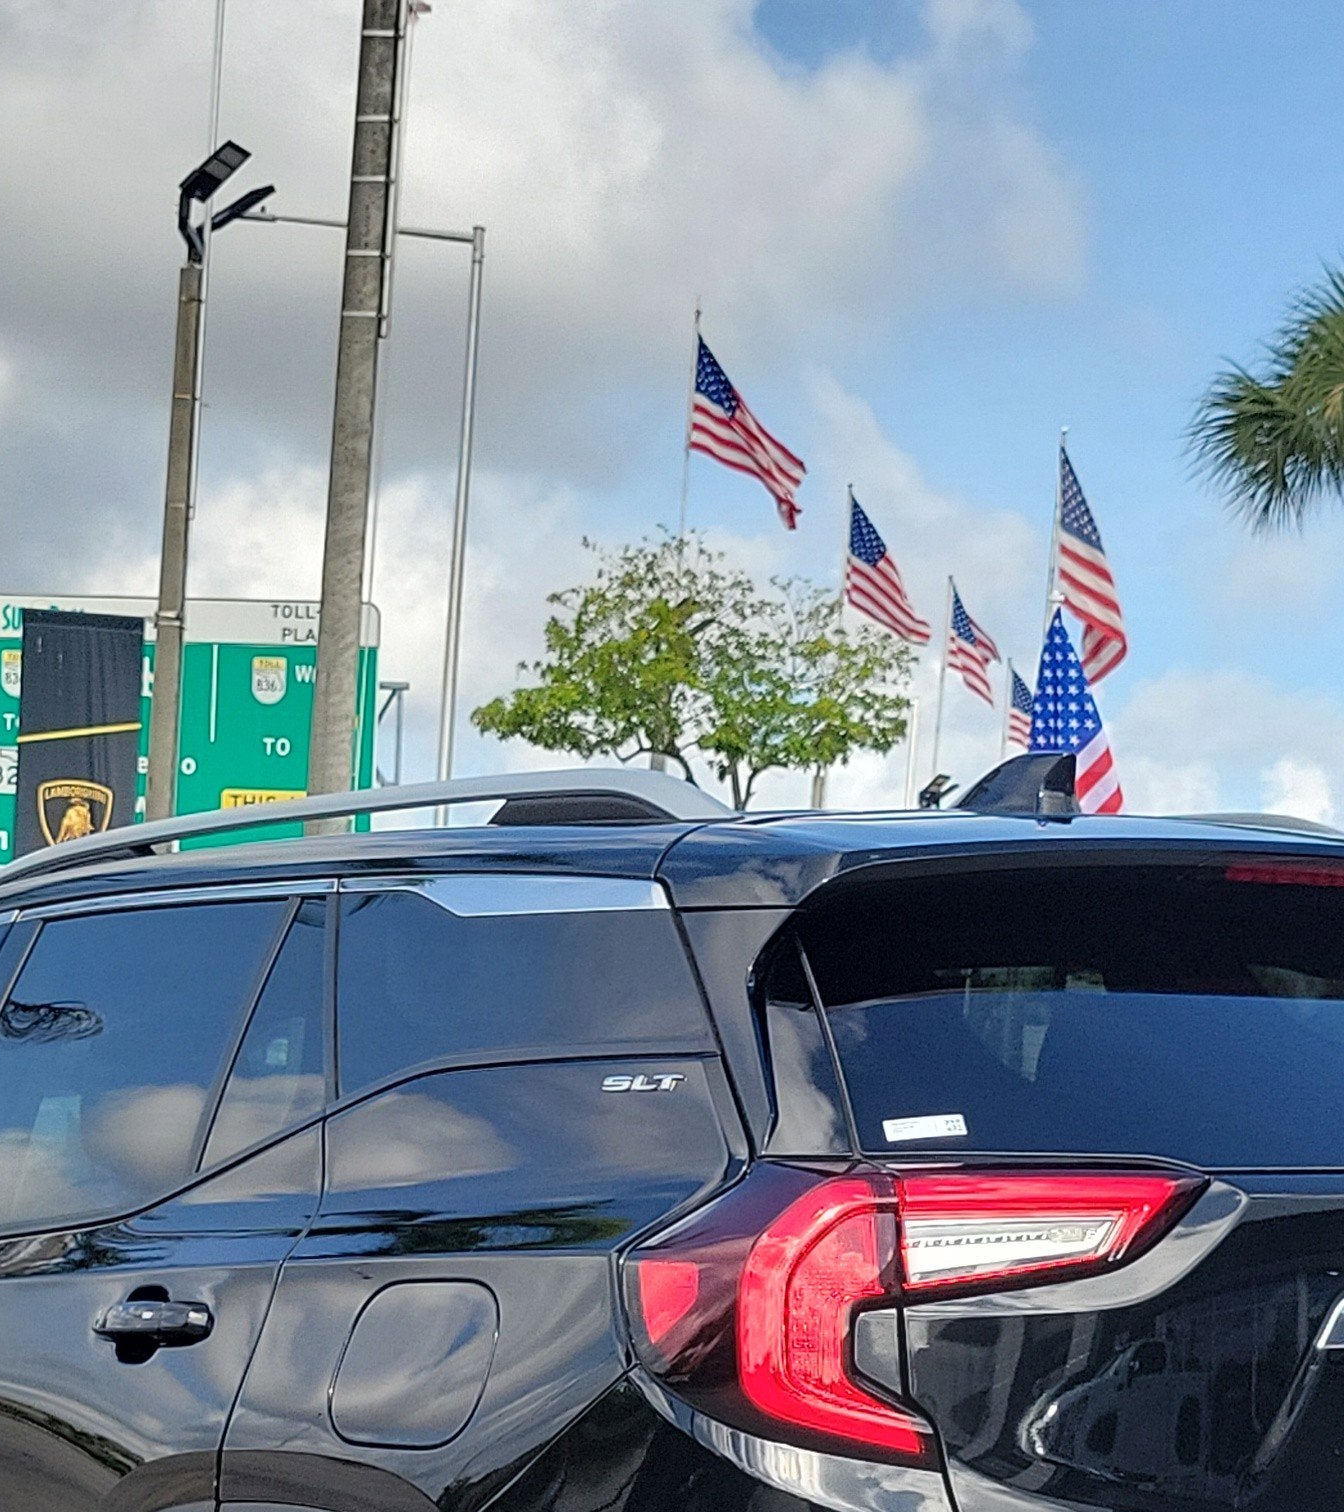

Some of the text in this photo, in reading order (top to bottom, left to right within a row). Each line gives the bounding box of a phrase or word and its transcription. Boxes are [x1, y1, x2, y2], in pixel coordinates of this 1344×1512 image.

[271, 604, 323, 620] TOLL-
[281, 627, 317, 643] PLA
[4, 672, 19, 686] 83
[2, 712, 20, 732] T
[262, 737, 291, 757] TO
[600, 1073, 687, 1093] SLT
